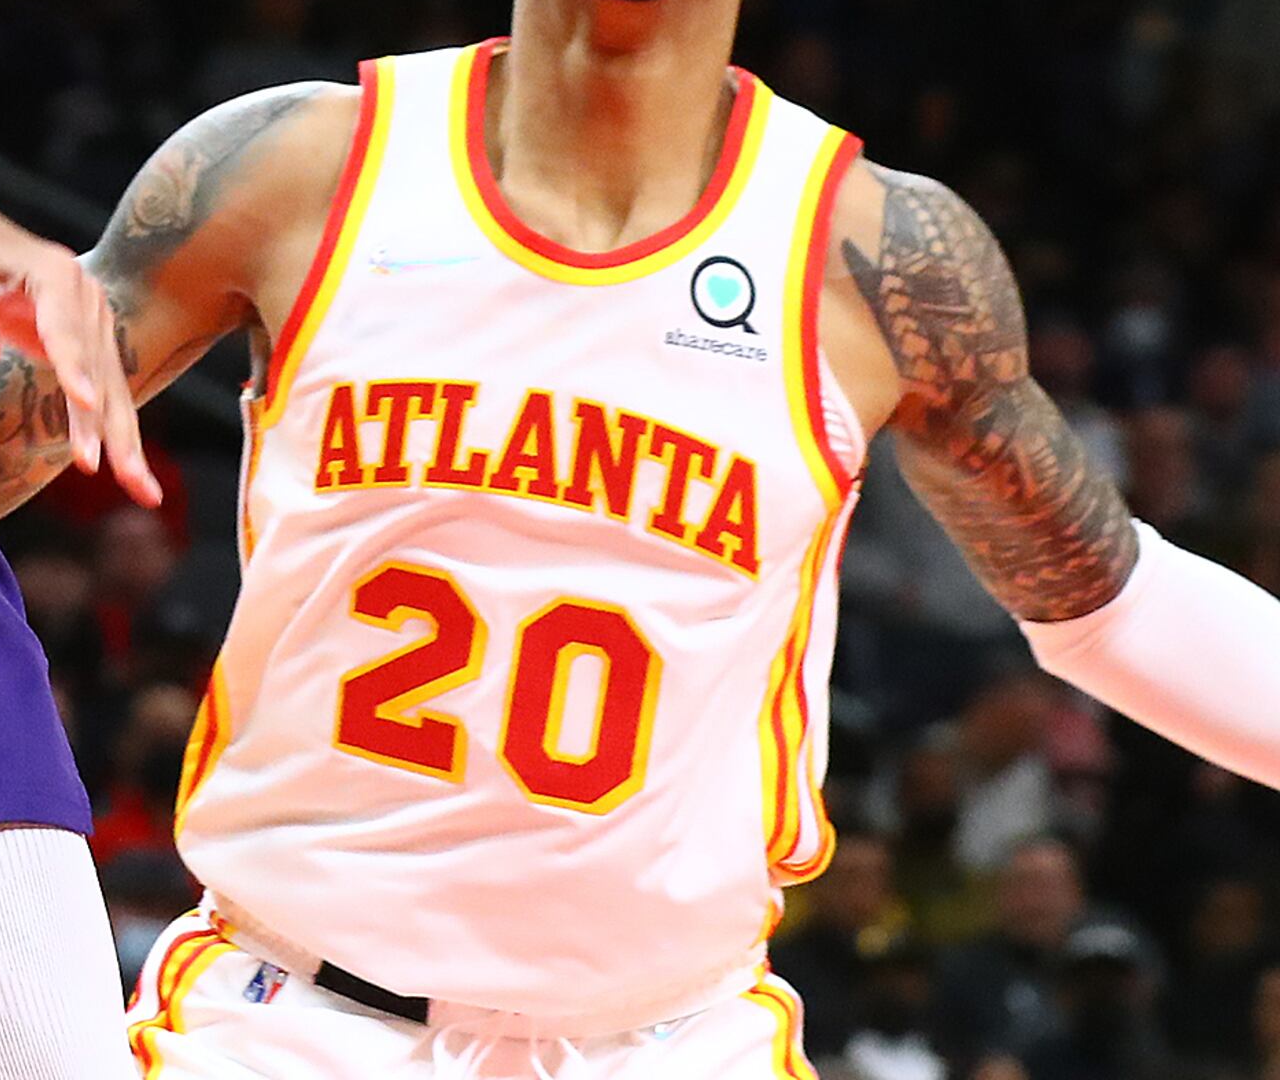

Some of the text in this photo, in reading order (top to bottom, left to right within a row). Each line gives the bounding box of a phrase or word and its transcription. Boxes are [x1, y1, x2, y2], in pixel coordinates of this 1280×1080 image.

[664, 328, 768, 362] sharecare
[314, 377, 762, 582] ATLANTA
[333, 558, 664, 816] 20
